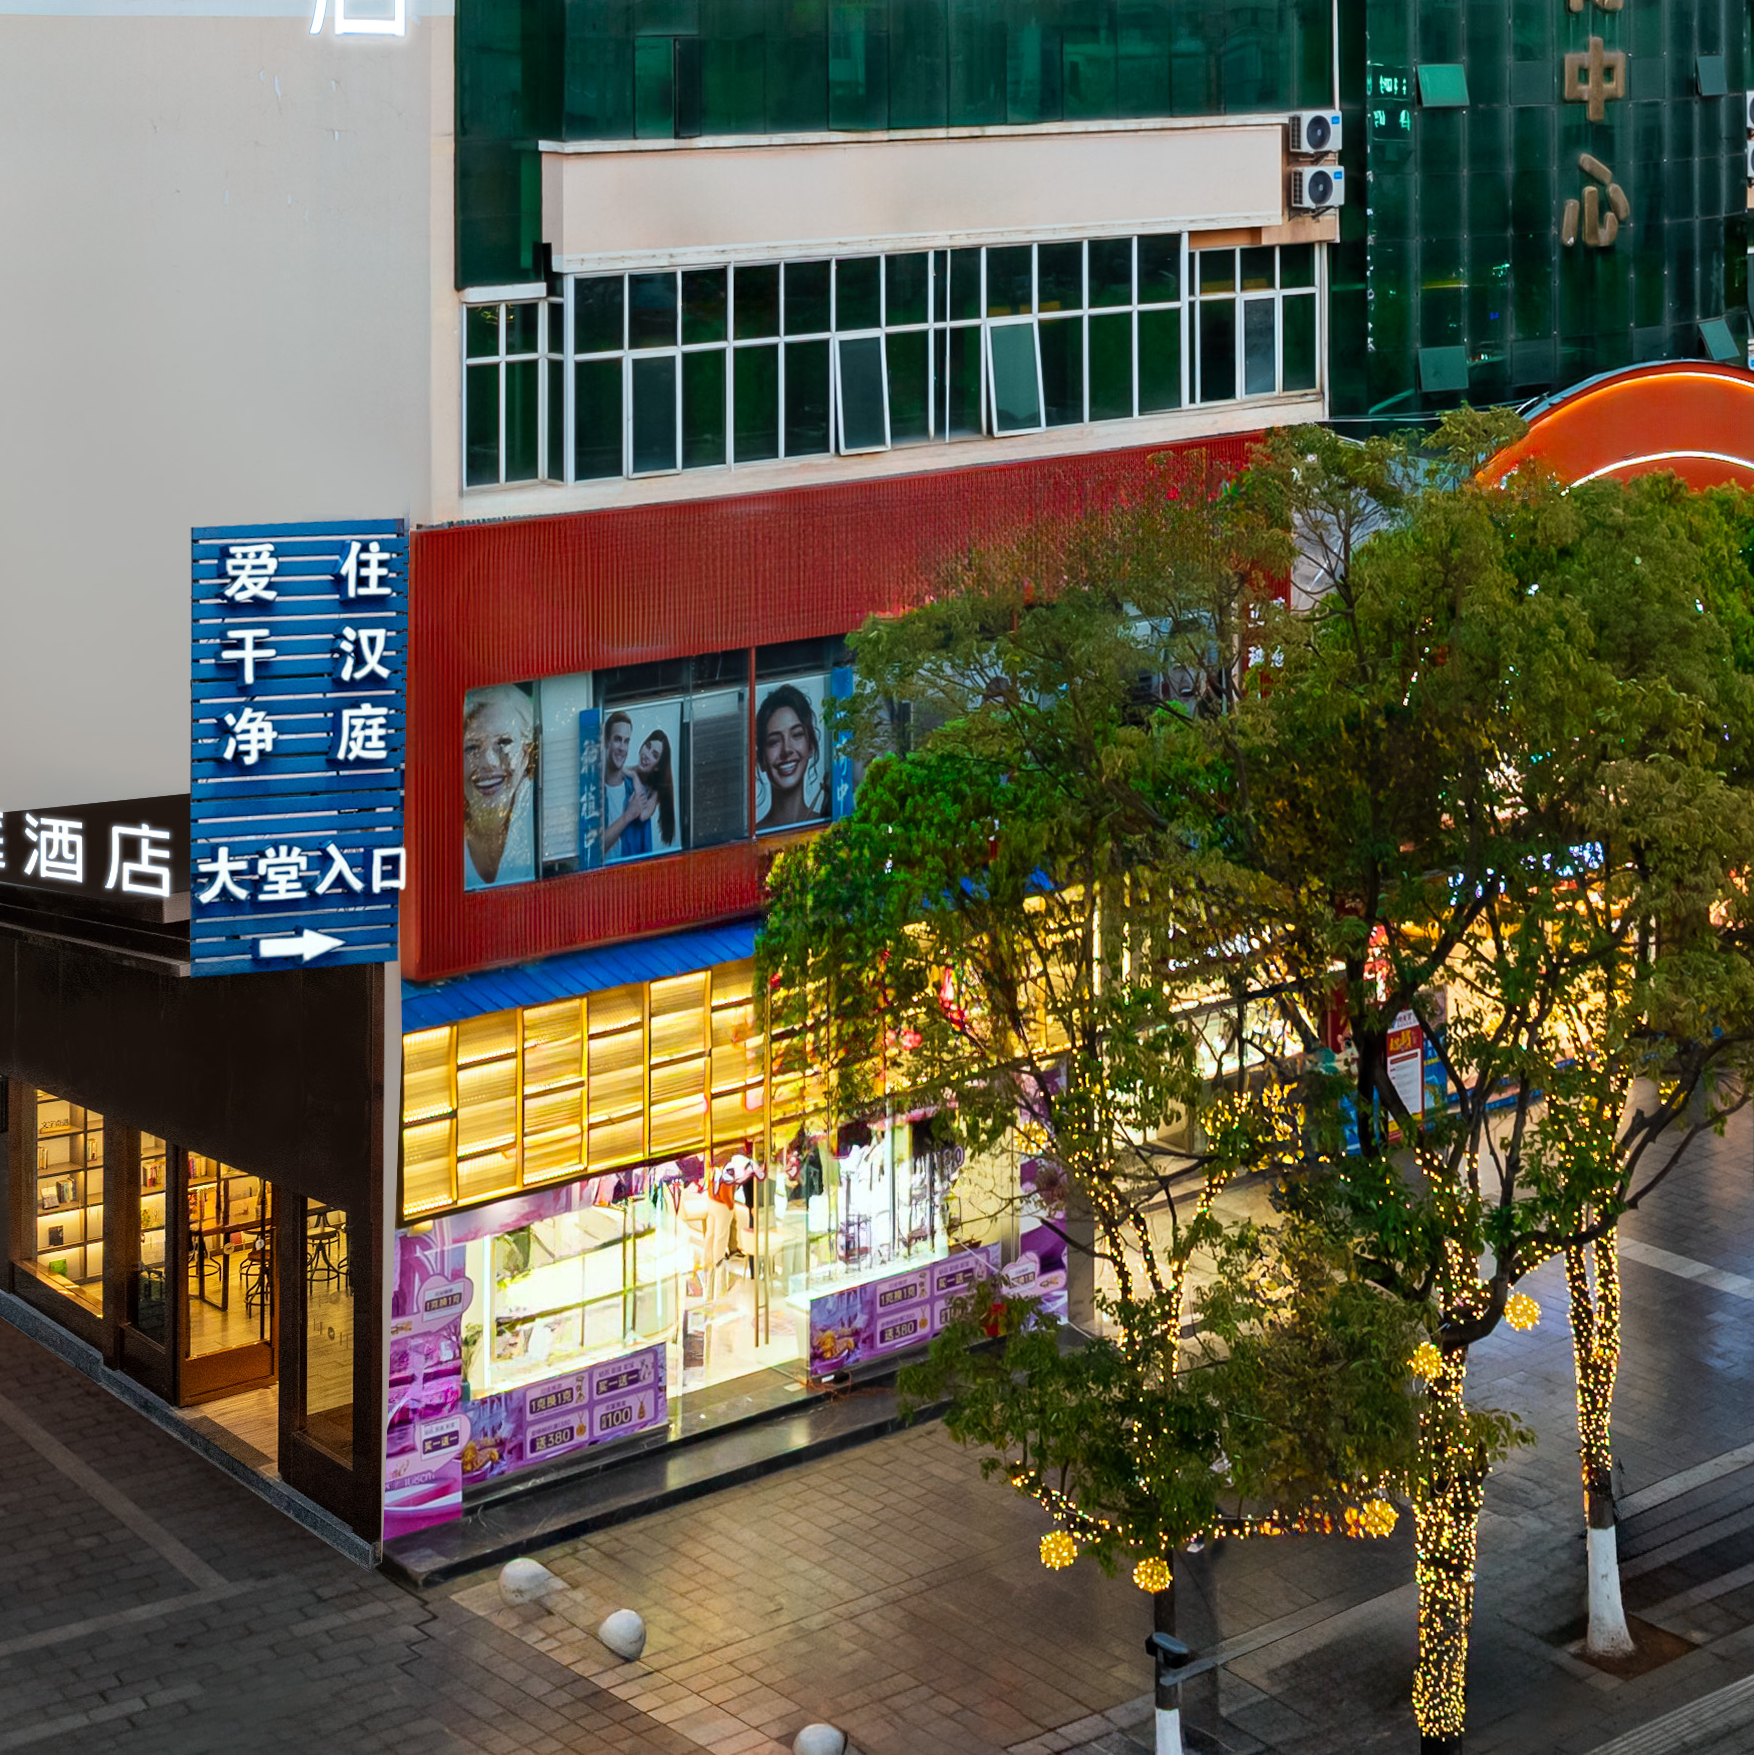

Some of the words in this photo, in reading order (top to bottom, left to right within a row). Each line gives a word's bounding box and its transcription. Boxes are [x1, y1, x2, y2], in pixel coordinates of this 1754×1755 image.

[222, 543, 278, 765] 爱干净
[336, 541, 392, 762] 住汉庭
[197, 842, 406, 904] 大堂入口
